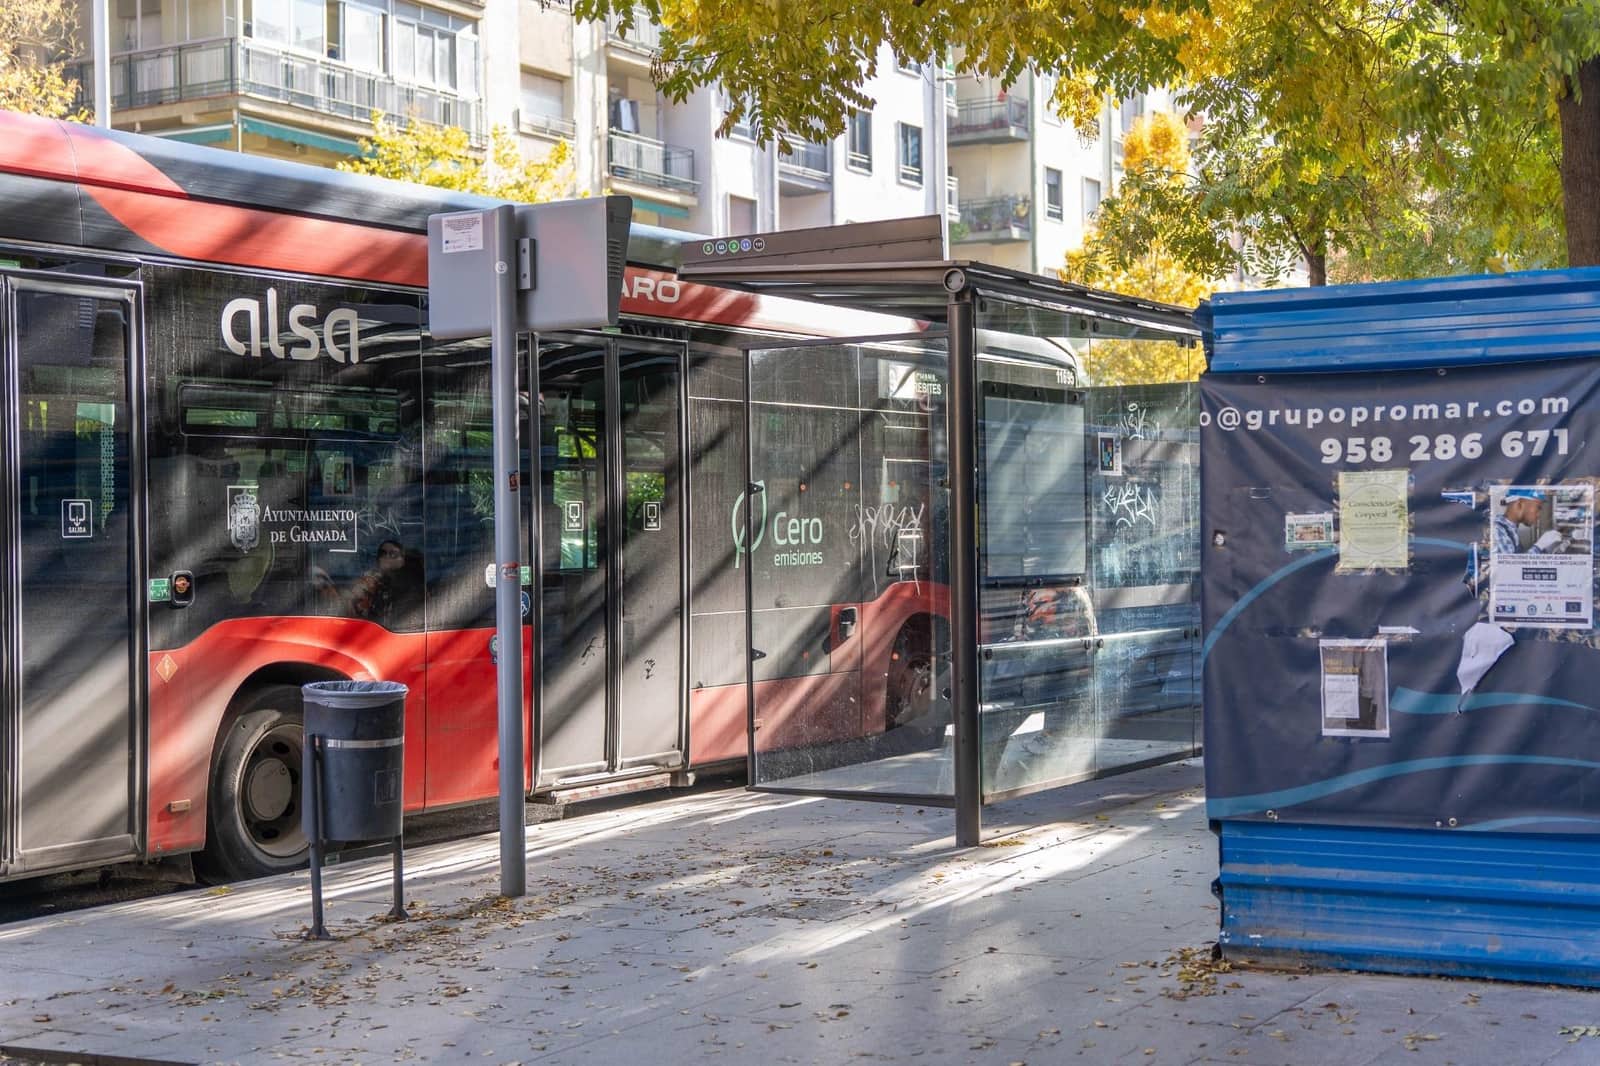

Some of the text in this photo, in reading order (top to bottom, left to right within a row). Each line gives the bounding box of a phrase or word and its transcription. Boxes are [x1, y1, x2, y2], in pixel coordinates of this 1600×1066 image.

[221, 287, 359, 364] alsa
[1320, 429, 1568, 463] 958 286 671
[262, 505, 354, 522] AYUNTAMIENTO
[271, 525, 347, 543] DE GRANADA
[773, 511, 823, 545] Cero
[774, 549, 823, 566] emisiones
